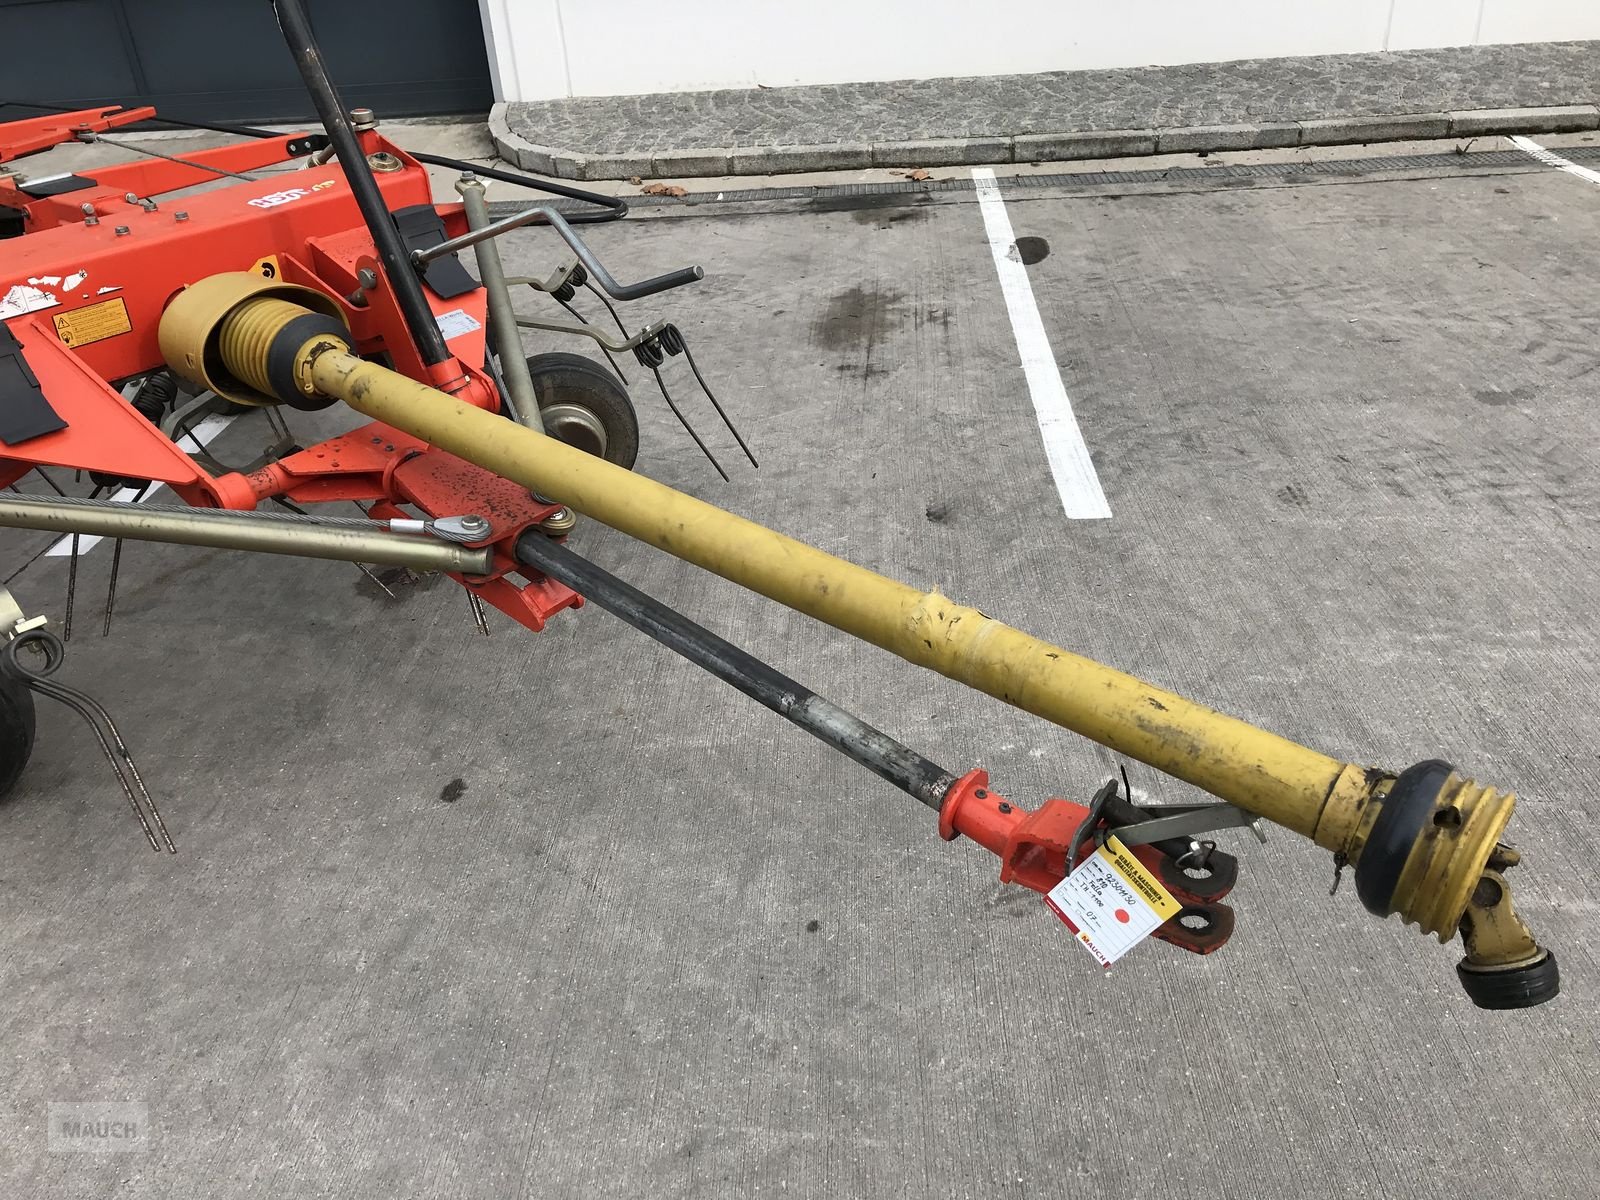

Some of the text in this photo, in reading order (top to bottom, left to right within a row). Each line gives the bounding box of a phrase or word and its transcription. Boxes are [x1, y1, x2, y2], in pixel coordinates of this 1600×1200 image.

[1114, 859, 1157, 904] QUALITÄTSKONTROLLE
[1118, 854, 1135, 872] GERÄTE
[1137, 874, 1162, 901] MASCHINEN
[1081, 935, 1106, 961] MAUCH
